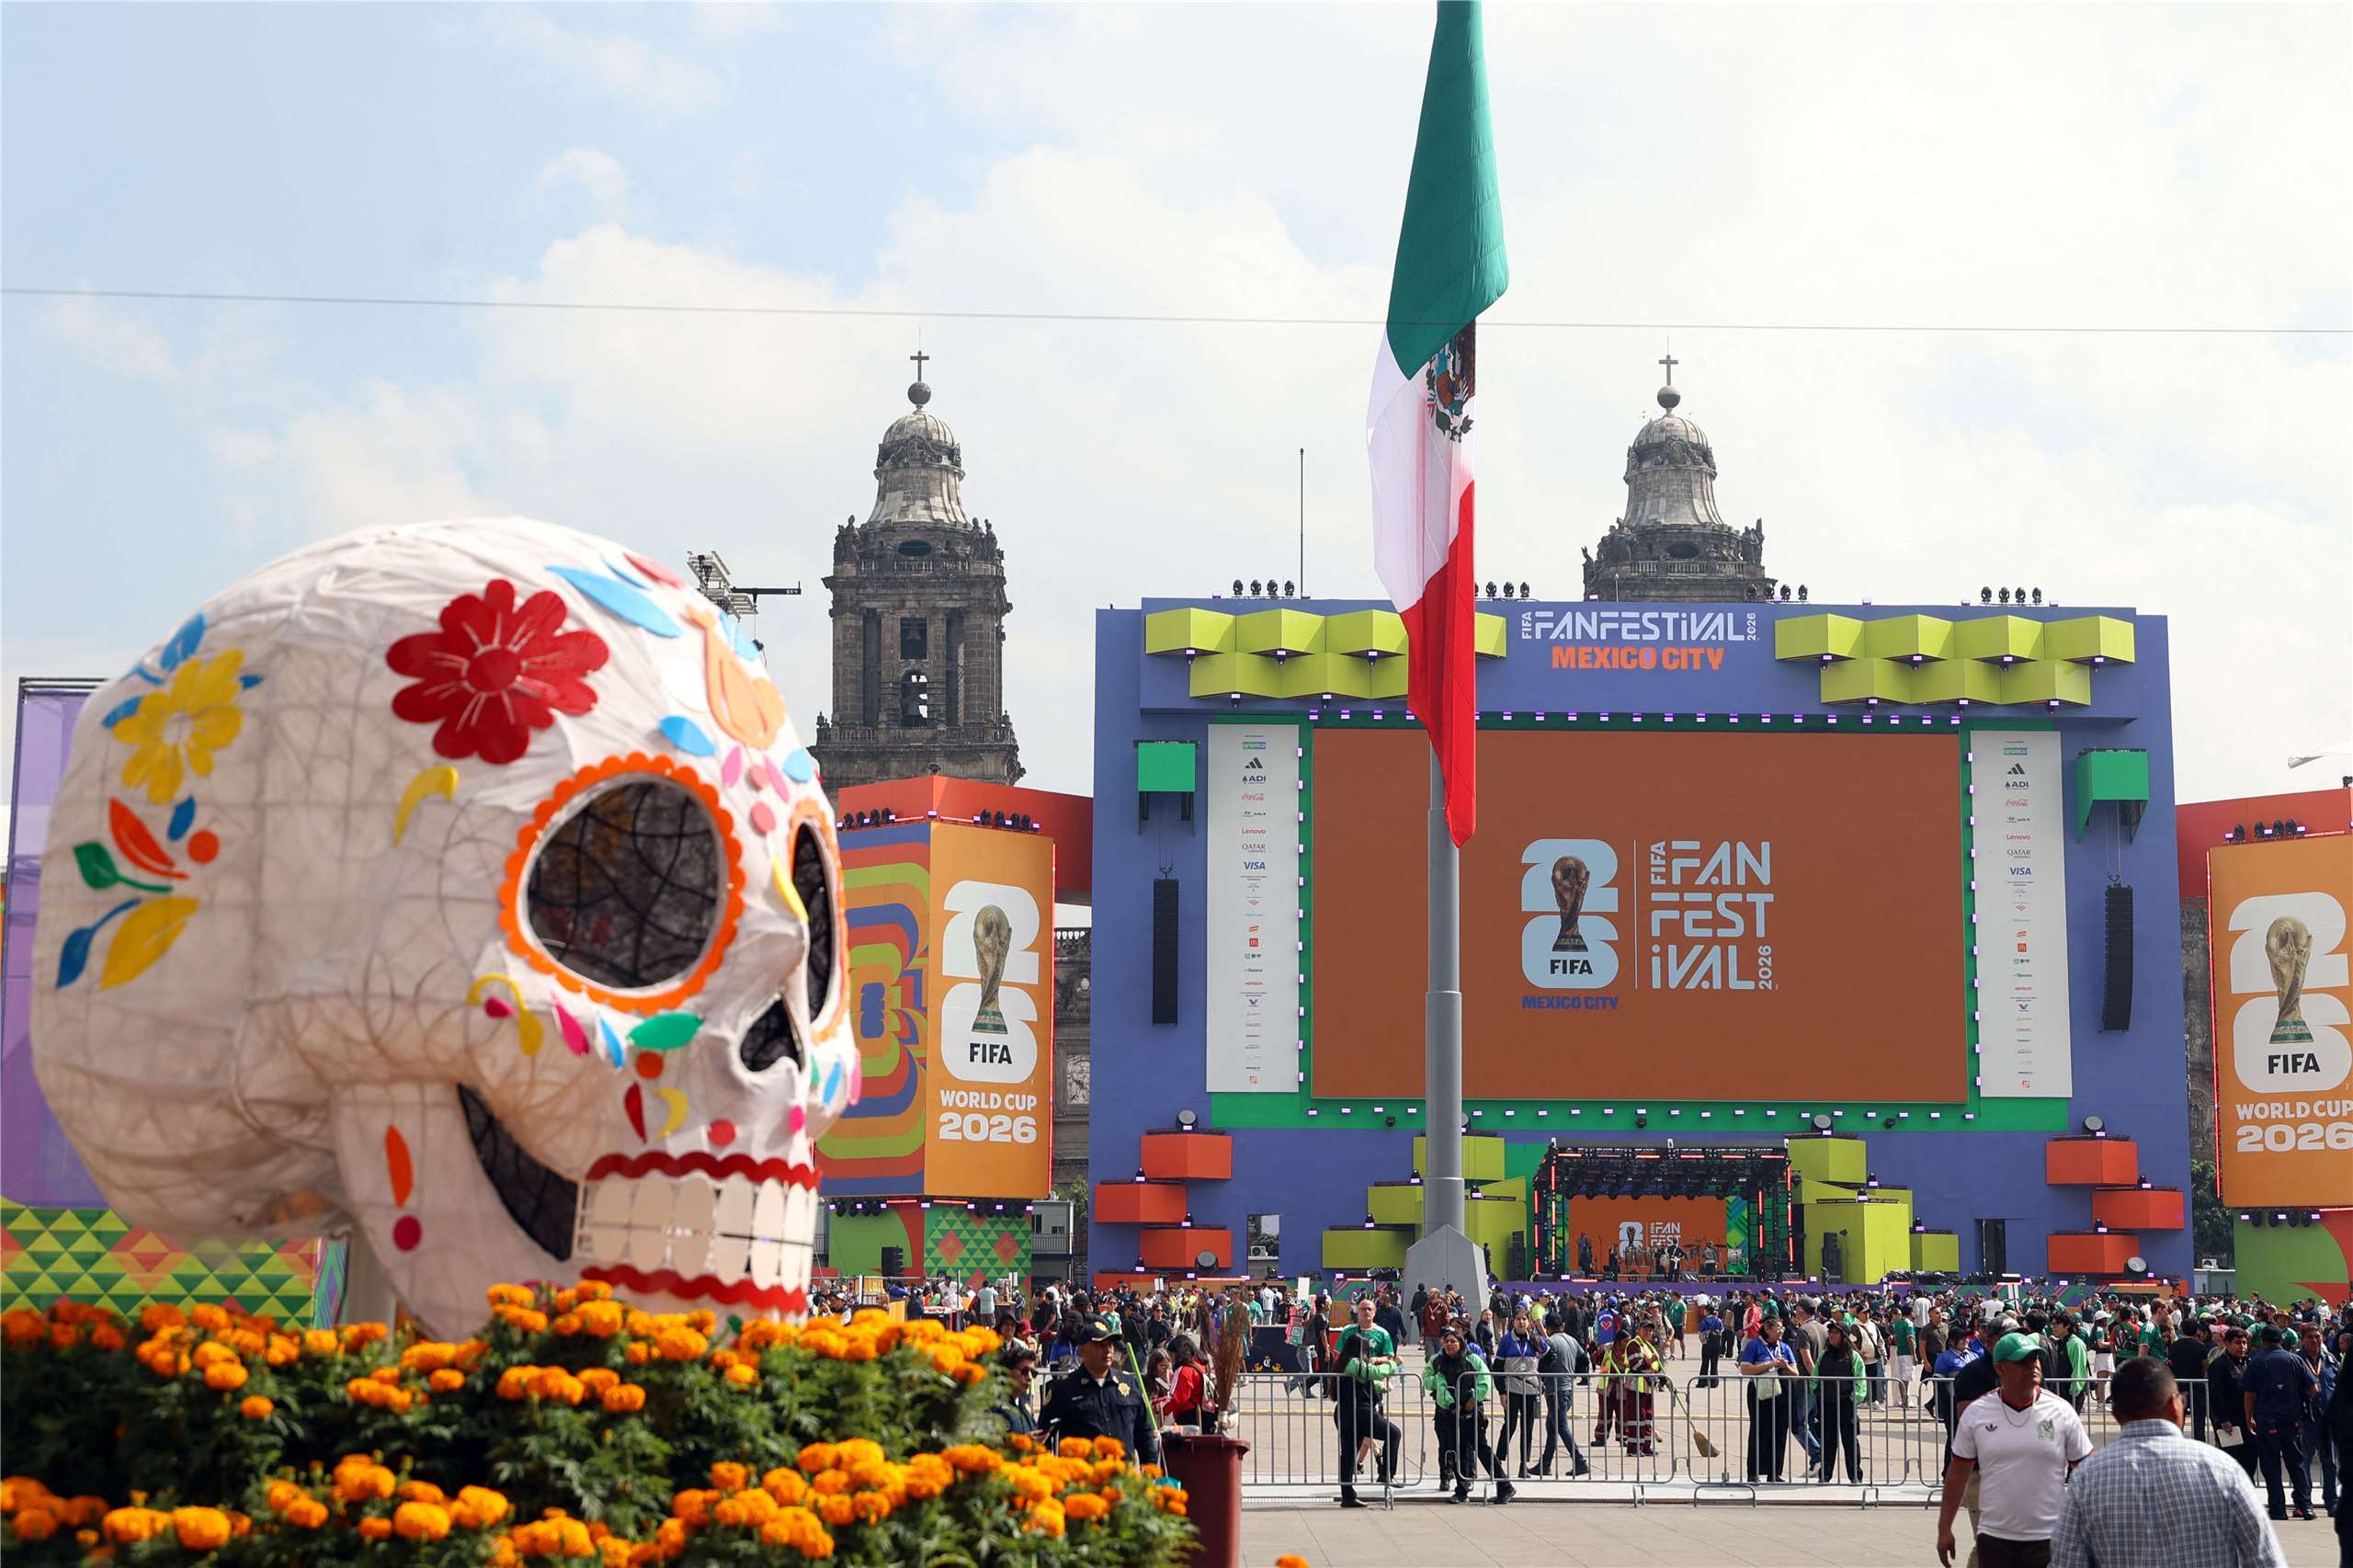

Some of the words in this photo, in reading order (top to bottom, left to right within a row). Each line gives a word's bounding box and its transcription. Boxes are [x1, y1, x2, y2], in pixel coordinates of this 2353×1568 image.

[1521, 611, 1532, 640] FIFA
[1747, 613, 1756, 641] 2026
[1552, 646, 1657, 670] MEXICO
[1662, 647, 1724, 670] CITY
[1650, 841, 1666, 885] FIFA
[1672, 841, 1770, 885] FAN
[1651, 892, 1774, 937] FEST
[1550, 959, 1593, 975] FIFA
[1758, 945, 1772, 989] 2026
[1522, 996, 1581, 1010] MEXICO
[1584, 996, 1618, 1010] CITY
[970, 1043, 1012, 1064] FIFA
[2268, 1053, 2321, 1074] FIFA
[940, 1089, 1001, 1110] WORLD
[1005, 1094, 1037, 1111] CUP
[2235, 1102, 2310, 1120] WORLD
[2313, 1099, 2353, 1118] CUP
[939, 1112, 1037, 1143] 2026
[2236, 1122, 2353, 1153] 2026
[1655, 1222, 1681, 1233] FAN
[1651, 1235, 1681, 1247] FEST
